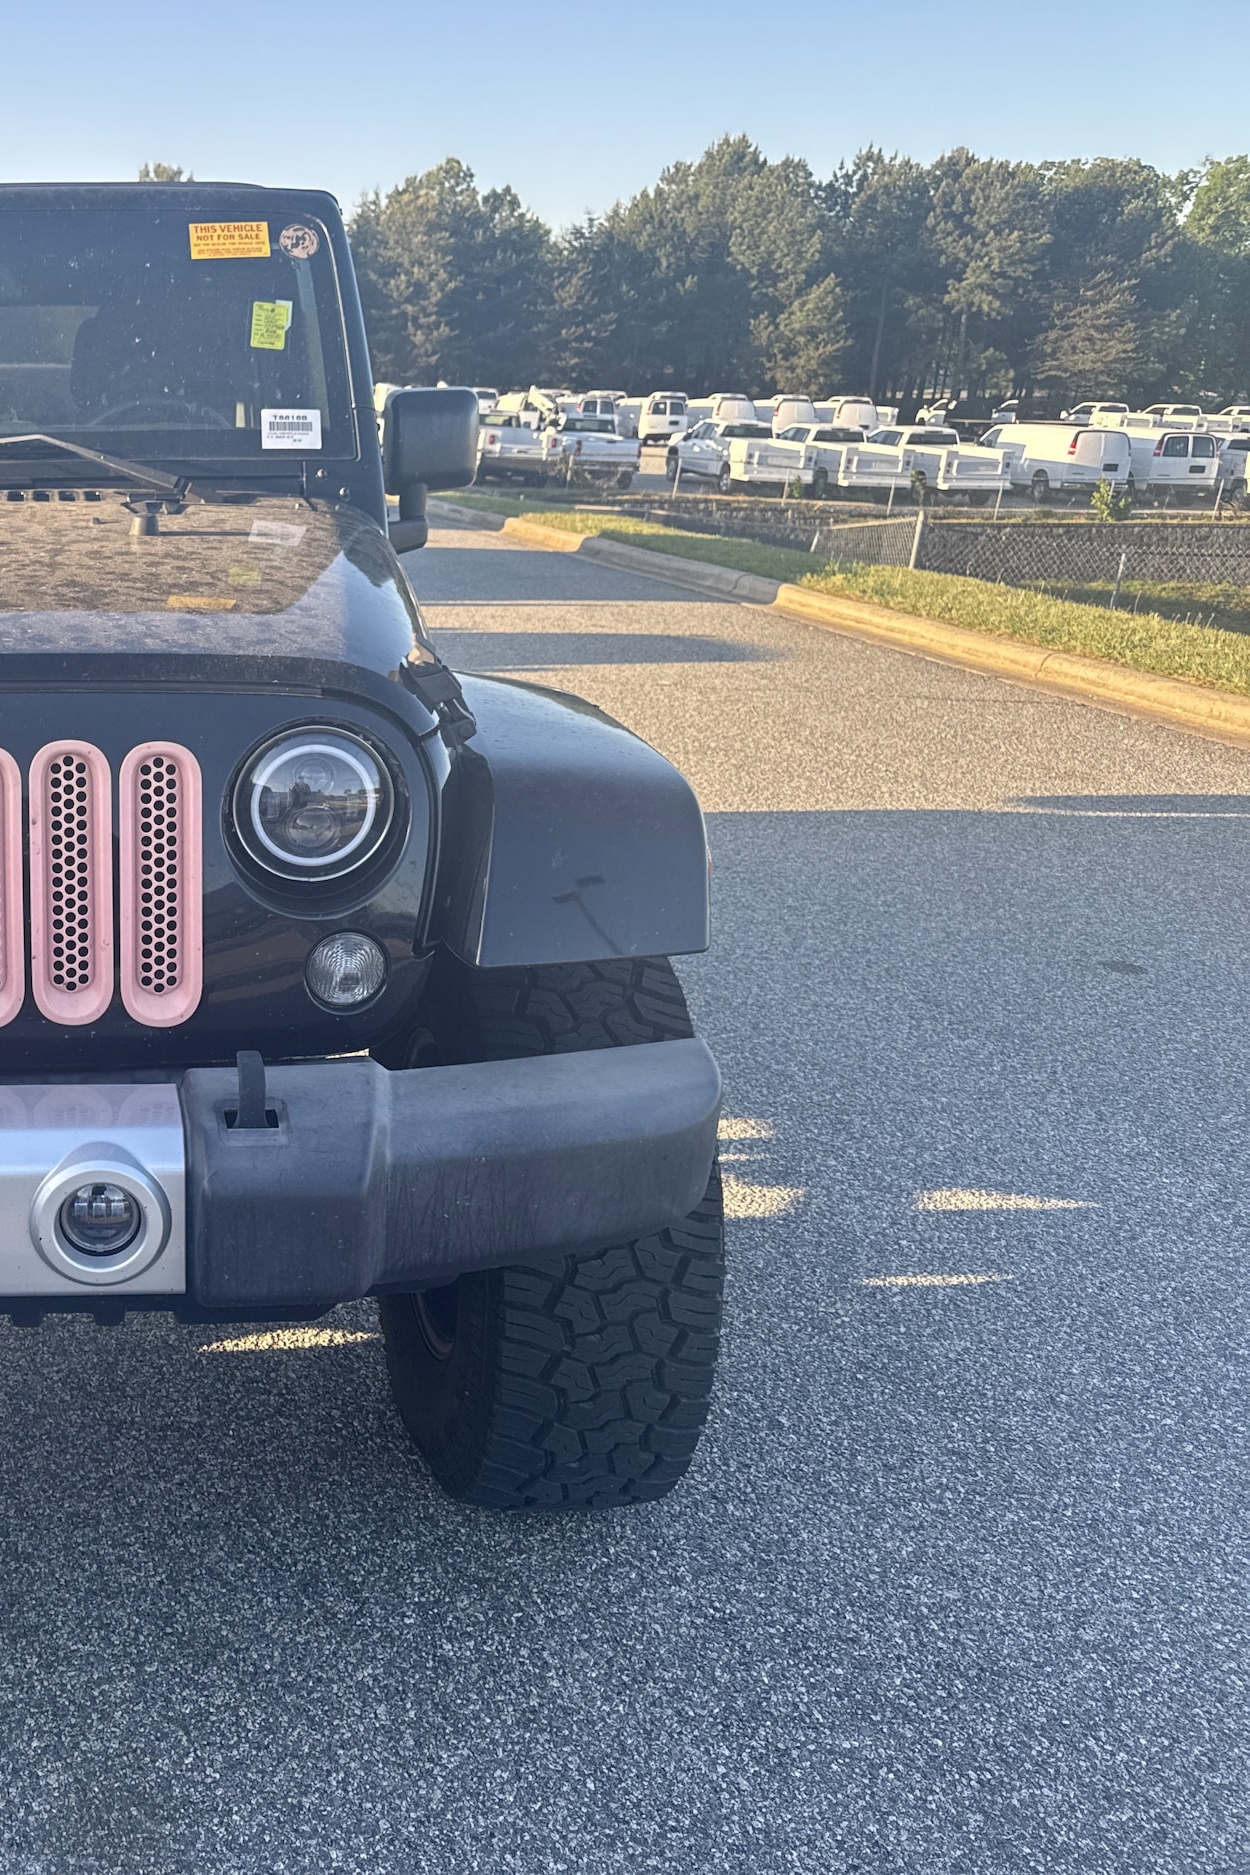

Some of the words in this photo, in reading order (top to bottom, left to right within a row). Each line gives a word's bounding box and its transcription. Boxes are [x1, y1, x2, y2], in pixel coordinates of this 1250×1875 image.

[194, 225, 217, 234] THIS
[219, 223, 263, 233] VEHICLE
[196, 234, 214, 242] NOT
[238, 233, 261, 241] SALE
